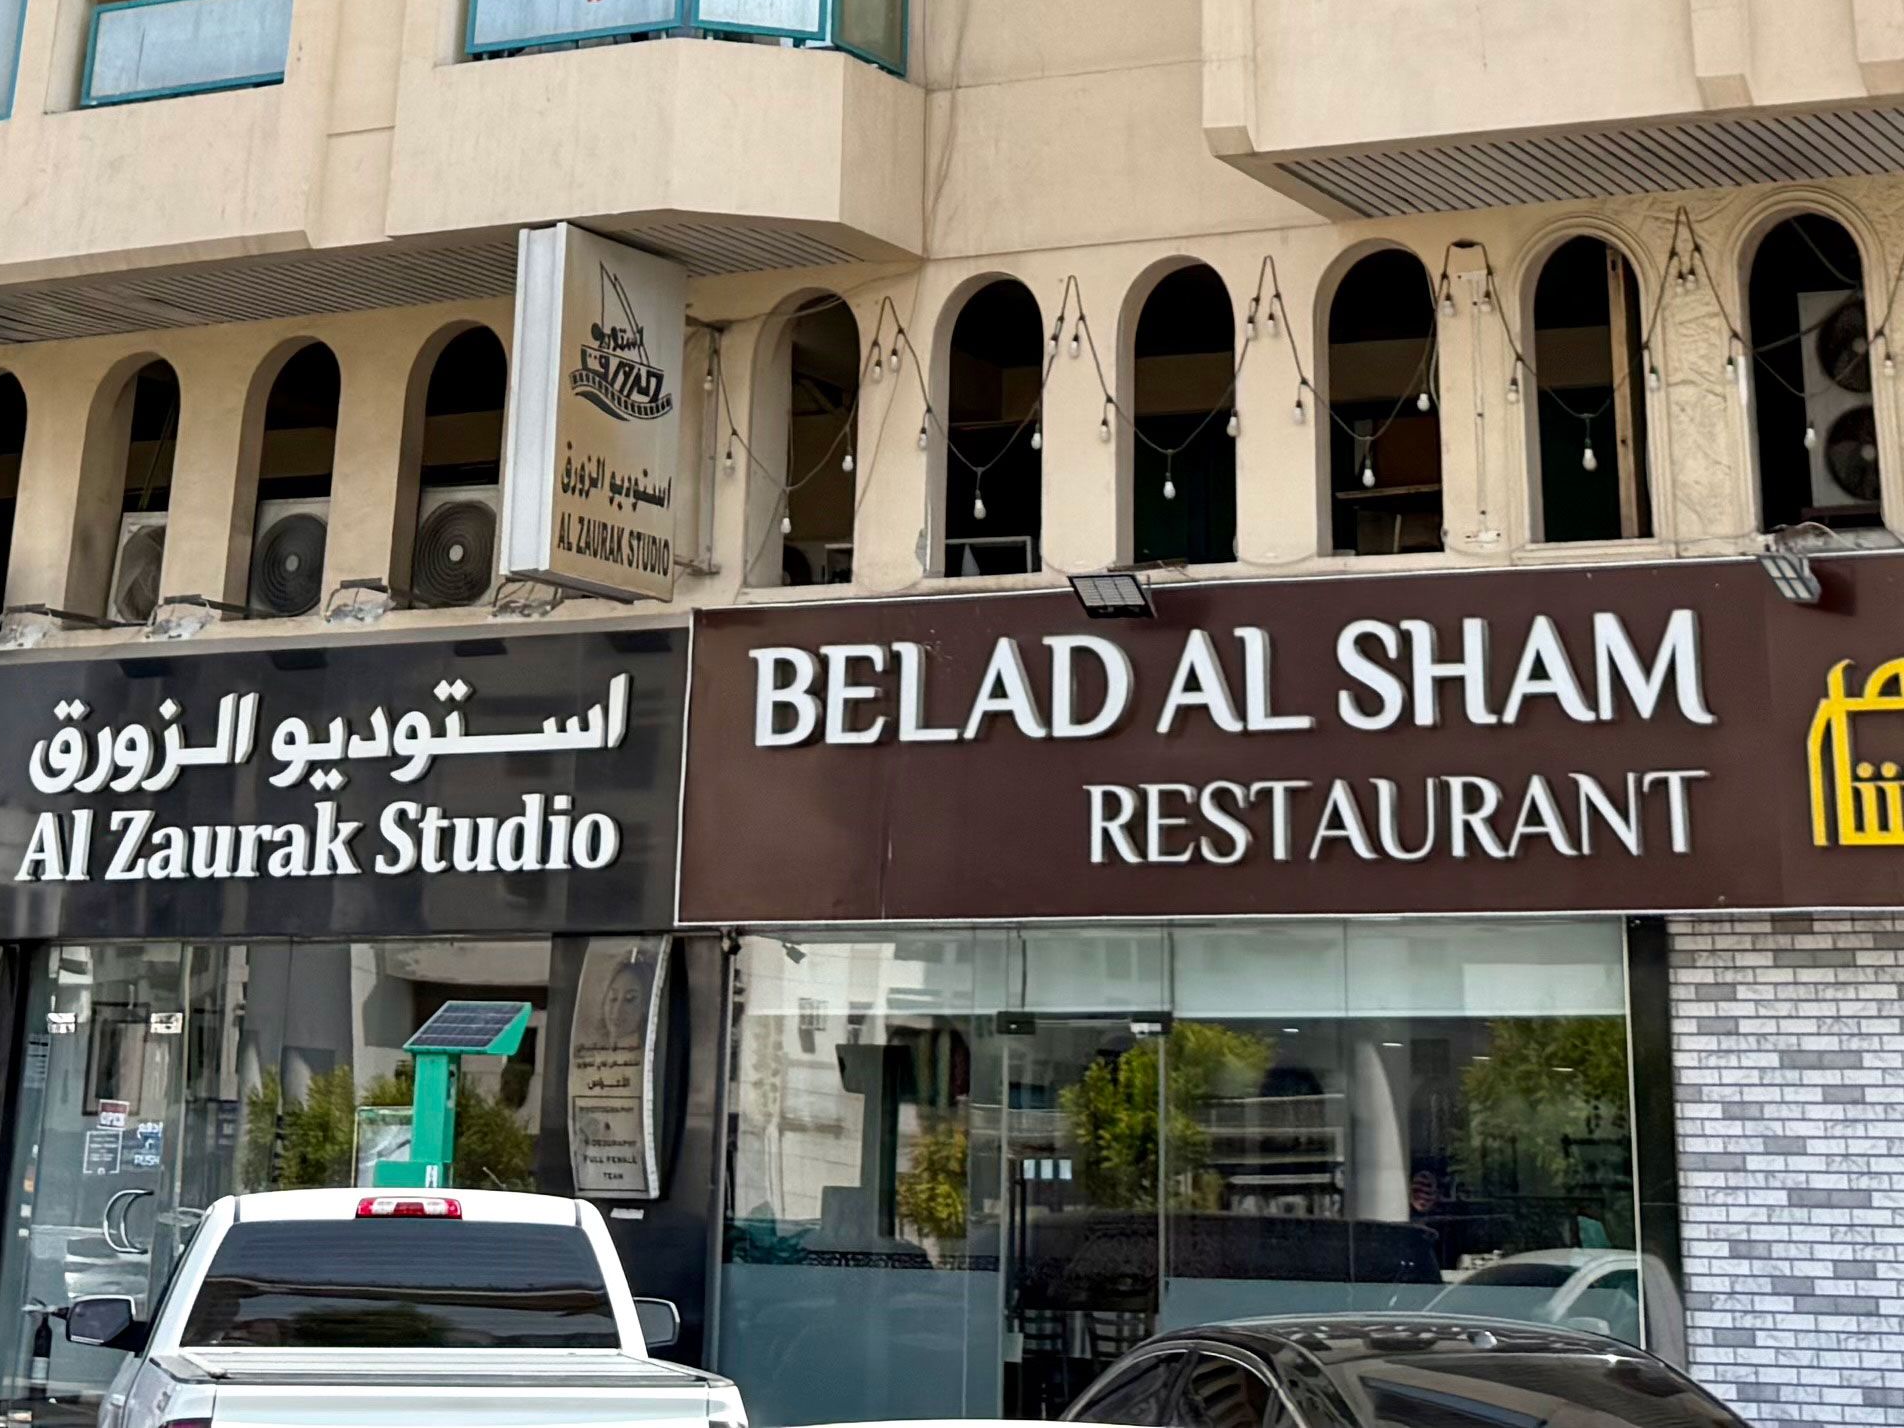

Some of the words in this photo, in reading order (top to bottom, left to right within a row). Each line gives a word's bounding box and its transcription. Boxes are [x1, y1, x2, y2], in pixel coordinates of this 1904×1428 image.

[557, 511, 572, 552] AL
[576, 515, 624, 565] ZAURAK
[627, 529, 670, 577] STUDIO
[750, 635, 1134, 746] BELAD
[1156, 626, 1310, 734] AL
[1338, 608, 1716, 730] SHAM
[29, 692, 259, 794] الزورق
[270, 672, 629, 790] استوديو
[15, 808, 91, 883] Al
[105, 801, 362, 881] Zaurak
[375, 793, 620, 875] Studio
[1085, 770, 1713, 863] RESTAURANT
